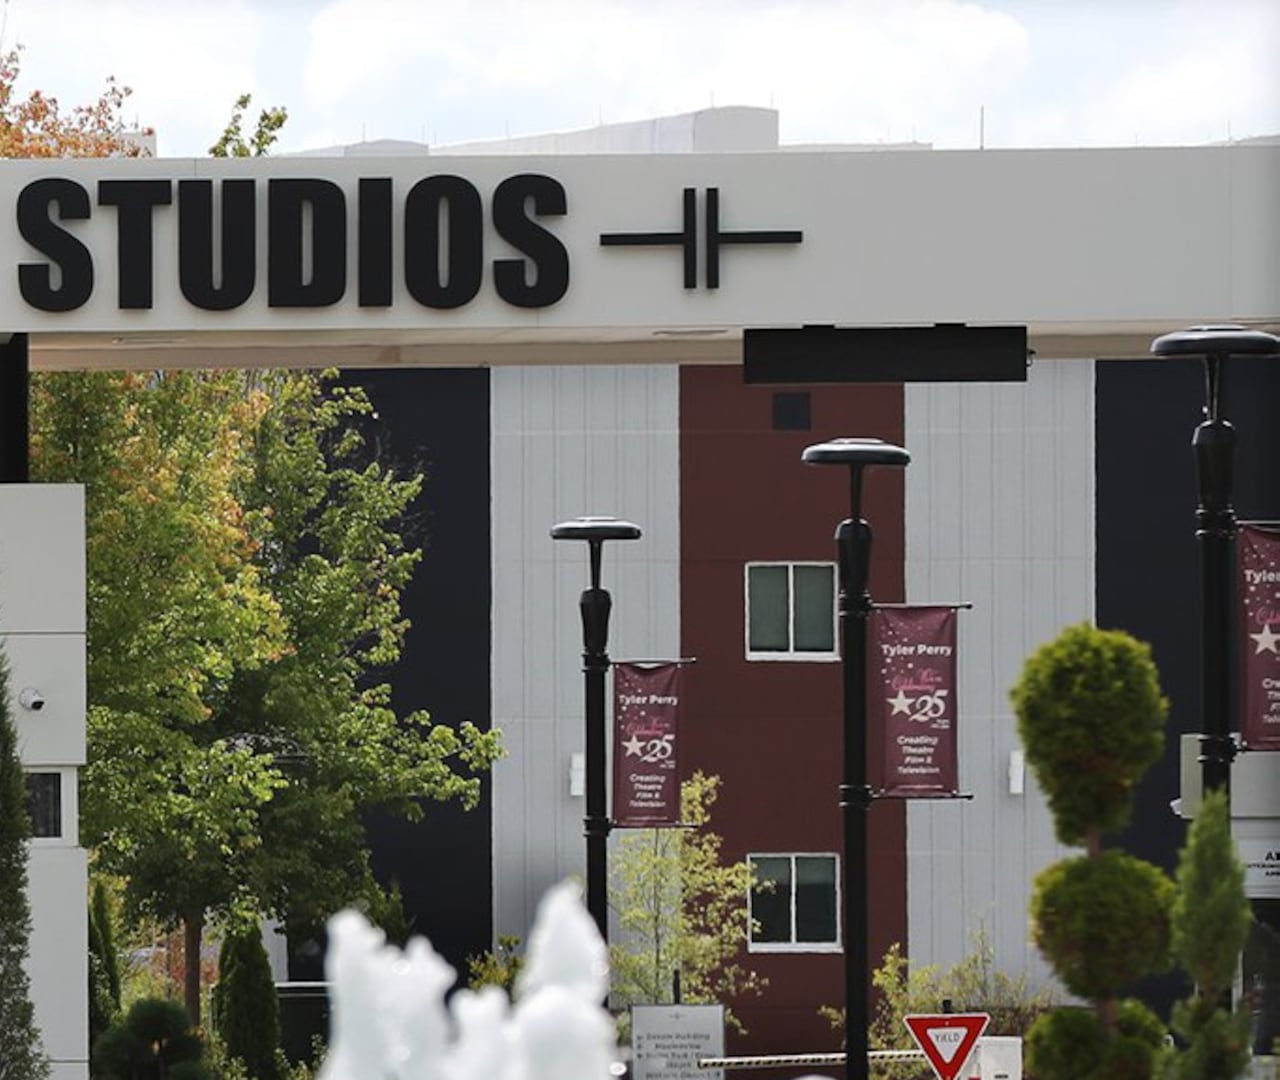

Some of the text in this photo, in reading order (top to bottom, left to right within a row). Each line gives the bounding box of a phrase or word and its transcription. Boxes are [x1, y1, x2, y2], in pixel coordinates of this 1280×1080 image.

[16, 174, 570, 312] STUDIOS
[881, 644, 952, 657] Tyler Perry
[619, 694, 678, 706] Tyler Perry
[908, 689, 949, 722] 25
[640, 734, 675, 763] 25
[934, 1031, 961, 1043] YIELD
